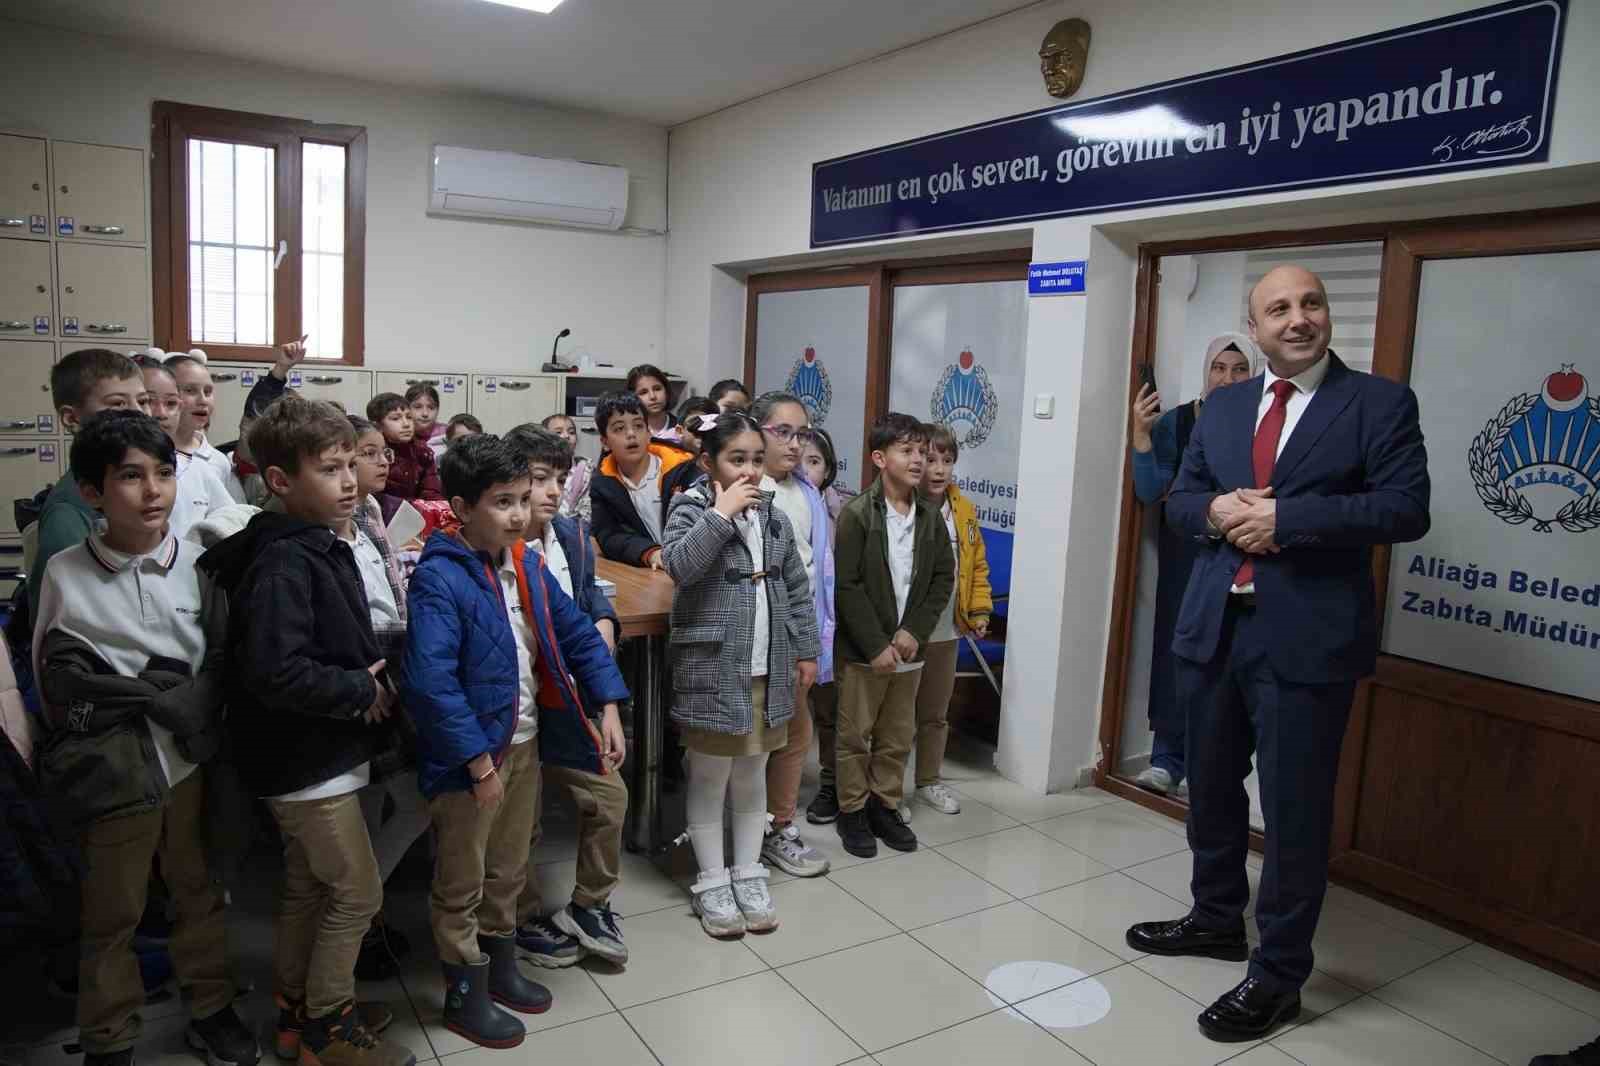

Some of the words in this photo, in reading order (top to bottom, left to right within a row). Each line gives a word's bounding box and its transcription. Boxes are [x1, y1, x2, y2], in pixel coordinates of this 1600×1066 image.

[822, 183, 892, 213] Vatanını
[897, 176, 921, 201] en
[928, 162, 965, 204] çok
[971, 154, 1048, 189] seven,
[1184, 121, 1227, 154] en
[1239, 101, 1281, 155] iyi
[1290, 67, 1503, 149] yapandır.
[1515, 467, 1589, 497] ALİAĞA
[1408, 554, 1498, 590] Aliağa
[1401, 590, 1492, 628] Zabıta
